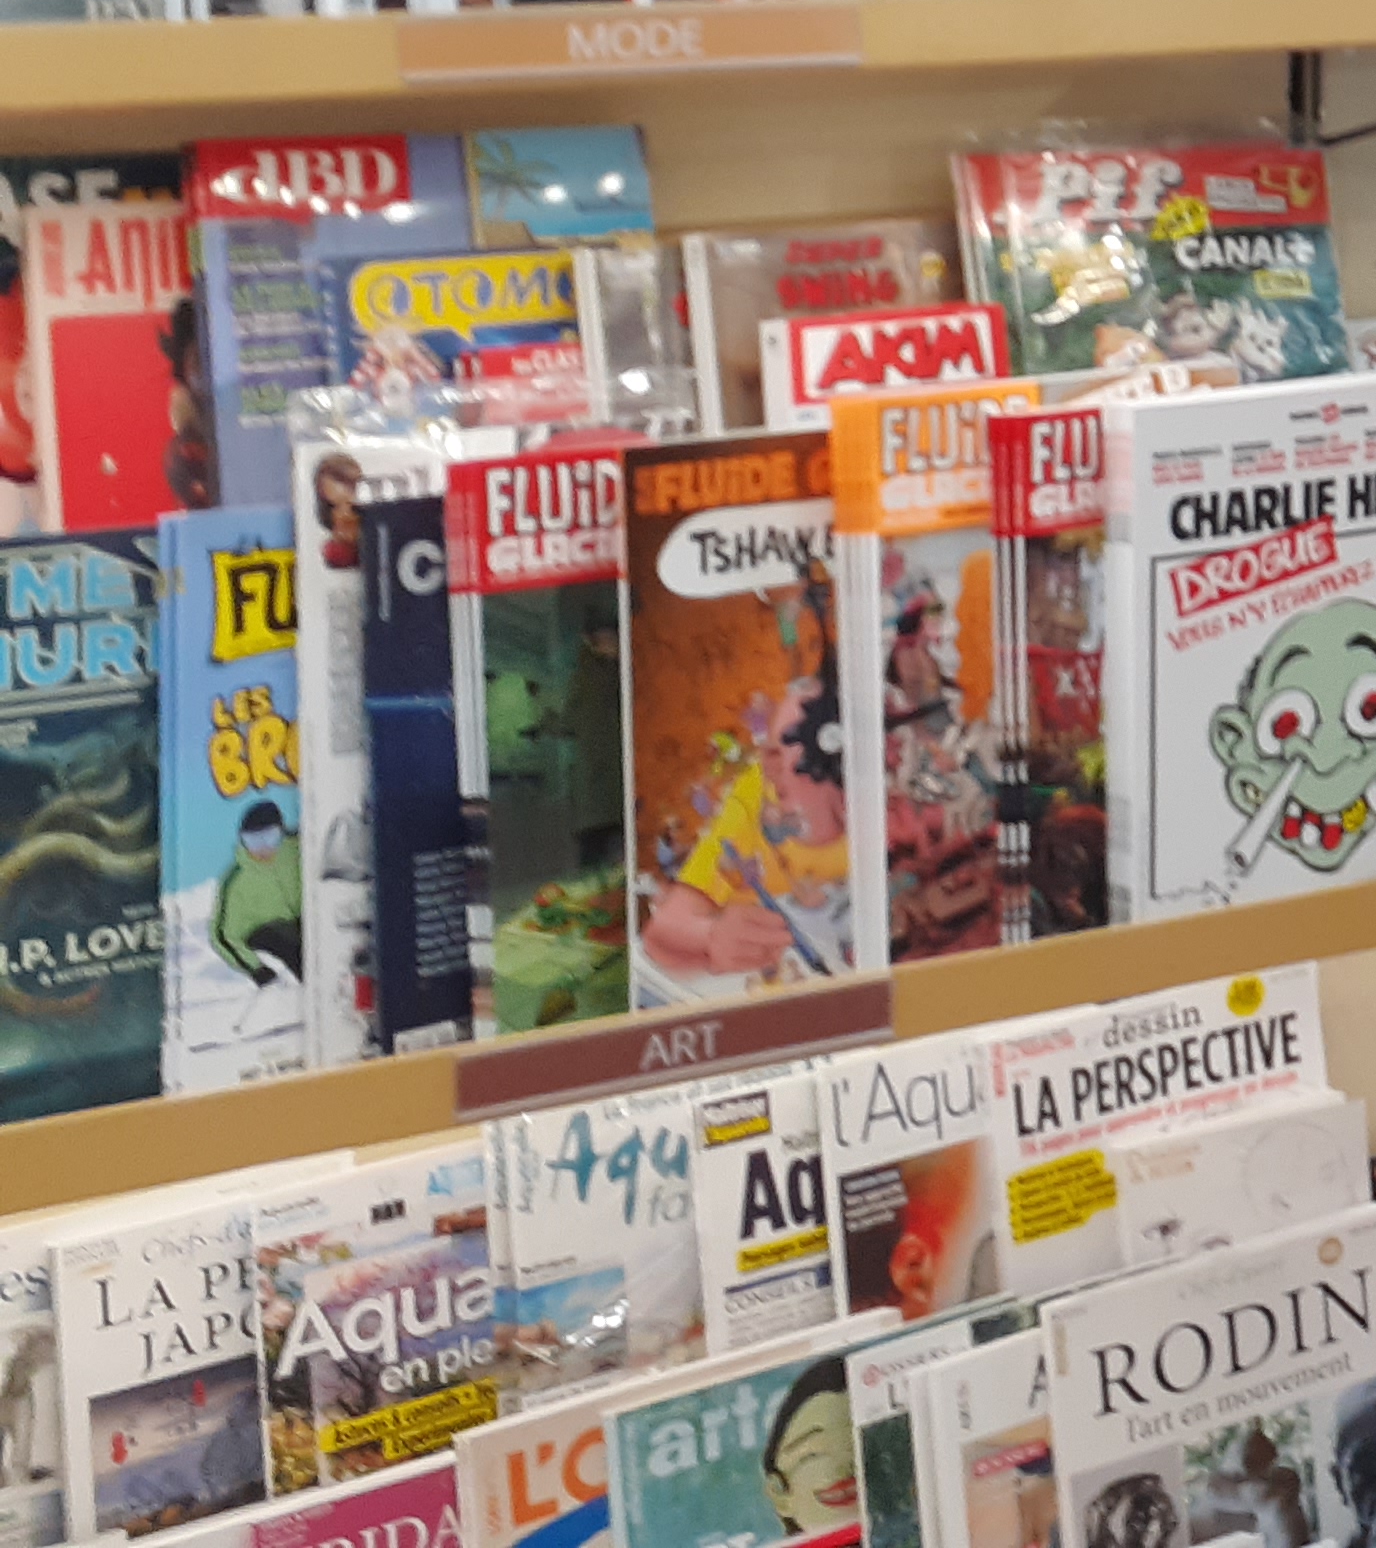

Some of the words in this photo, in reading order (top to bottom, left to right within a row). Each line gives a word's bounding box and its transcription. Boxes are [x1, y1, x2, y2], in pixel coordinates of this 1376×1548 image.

[565, 18, 706, 61] MODE
[1175, 232, 1317, 271] CANAL+
[1170, 476, 1337, 540] CHARLIE
[1174, 520, 1334, 608] DROGUE
[639, 1019, 723, 1071] ART
[1103, 997, 1204, 1049] dessin
[1014, 1081, 1061, 1138] LA
[1072, 1012, 1302, 1124] PERSPECTIVE
[96, 1275, 176, 1330] LA
[1091, 1269, 1376, 1419] RODIN
[1179, 1400, 1211, 1431] en
[1214, 1354, 1357, 1424] mouvement
